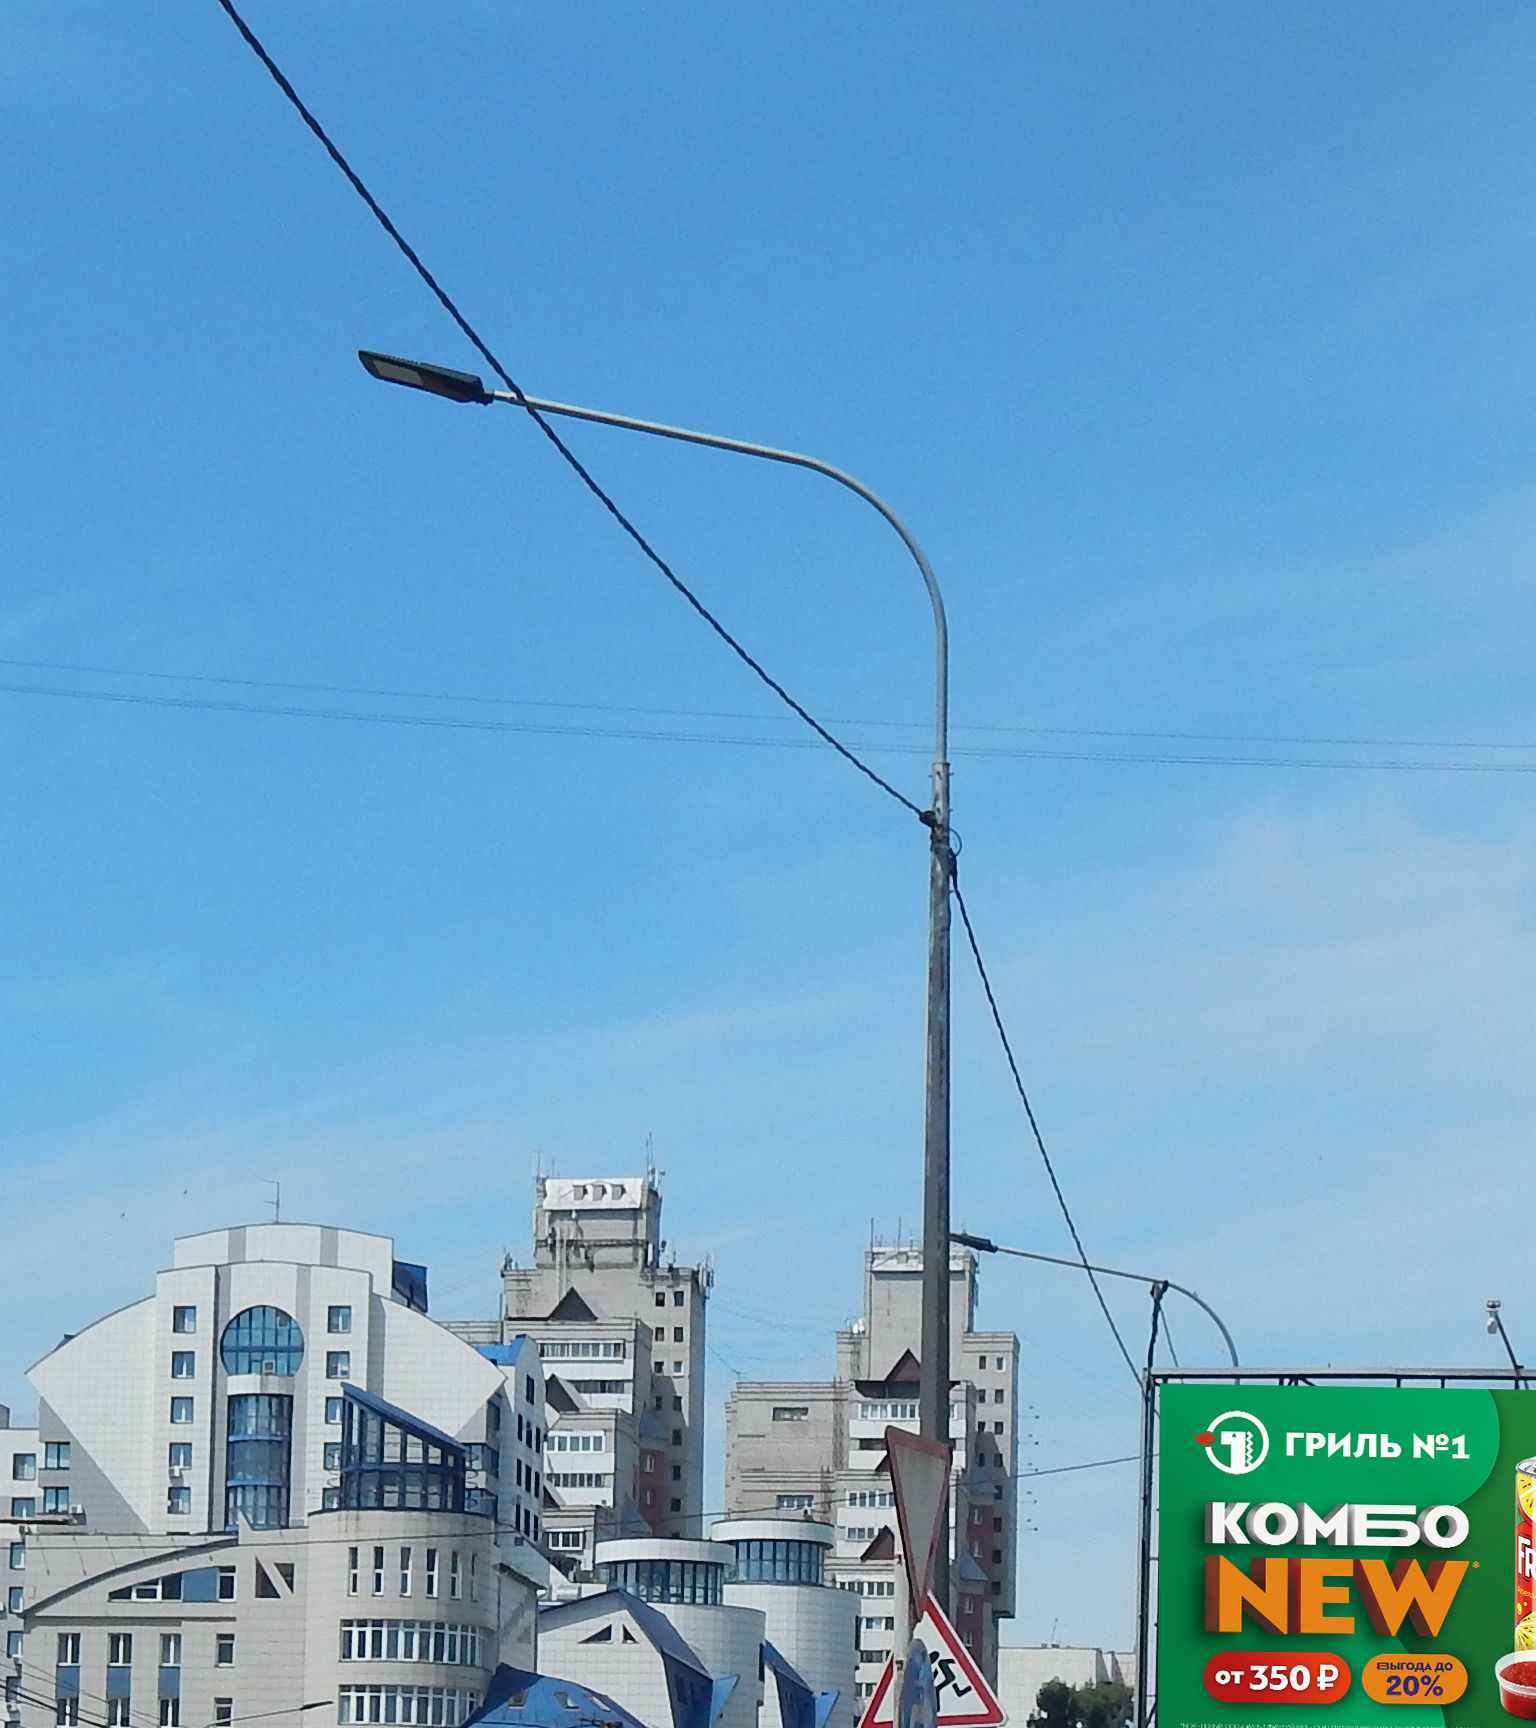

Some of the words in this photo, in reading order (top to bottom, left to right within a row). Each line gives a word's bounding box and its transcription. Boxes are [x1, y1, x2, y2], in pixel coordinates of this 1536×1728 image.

[1285, 1431, 1403, 1458] ГРИЛЬ
[1412, 1433, 1471, 1459] №1
[1207, 1502, 1470, 1548] КОМБО
[1207, 1555, 1470, 1637] NEW
[1215, 1669, 1244, 1685] от
[1249, 1665, 1311, 1691] 350
[1376, 1661, 1432, 1673] ВЫГОДА
[1434, 1661, 1453, 1673] ДО
[1386, 1675, 1444, 1697] 20%
